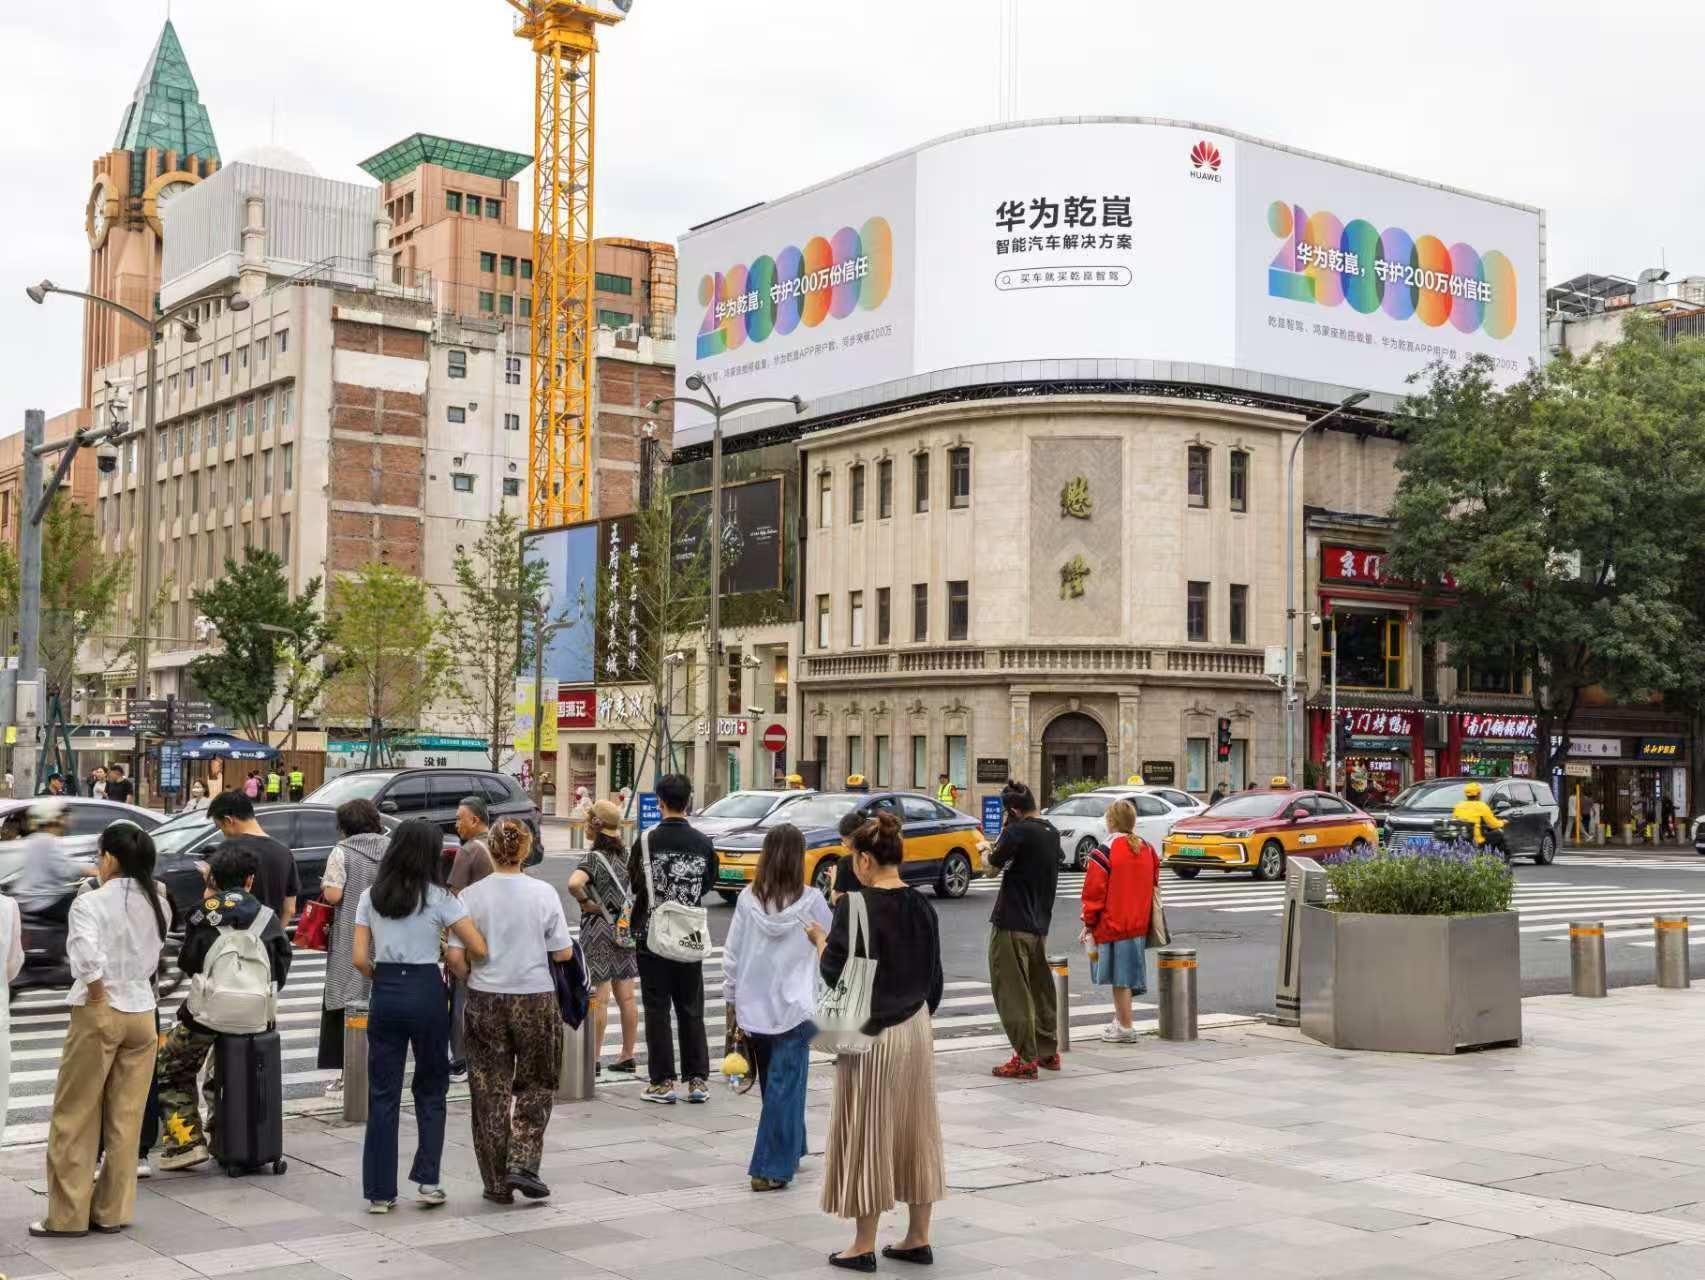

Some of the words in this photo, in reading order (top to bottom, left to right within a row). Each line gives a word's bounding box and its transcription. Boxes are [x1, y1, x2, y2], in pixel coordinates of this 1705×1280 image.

[1190, 170, 1222, 184] HUAWEI
[995, 195, 1133, 232] 华为乾崑
[996, 234, 1132, 254] 智能汽车解决方案
[1021, 271, 1119, 284] 买车就买乾崑智驾
[1296, 242, 1492, 303] 华为乾崑，守护200万份信任
[715, 256, 869, 320] 华为乾崑，守护200万份信任
[697, 719, 738, 735] swtch
[679, 940, 704, 952] adidas
